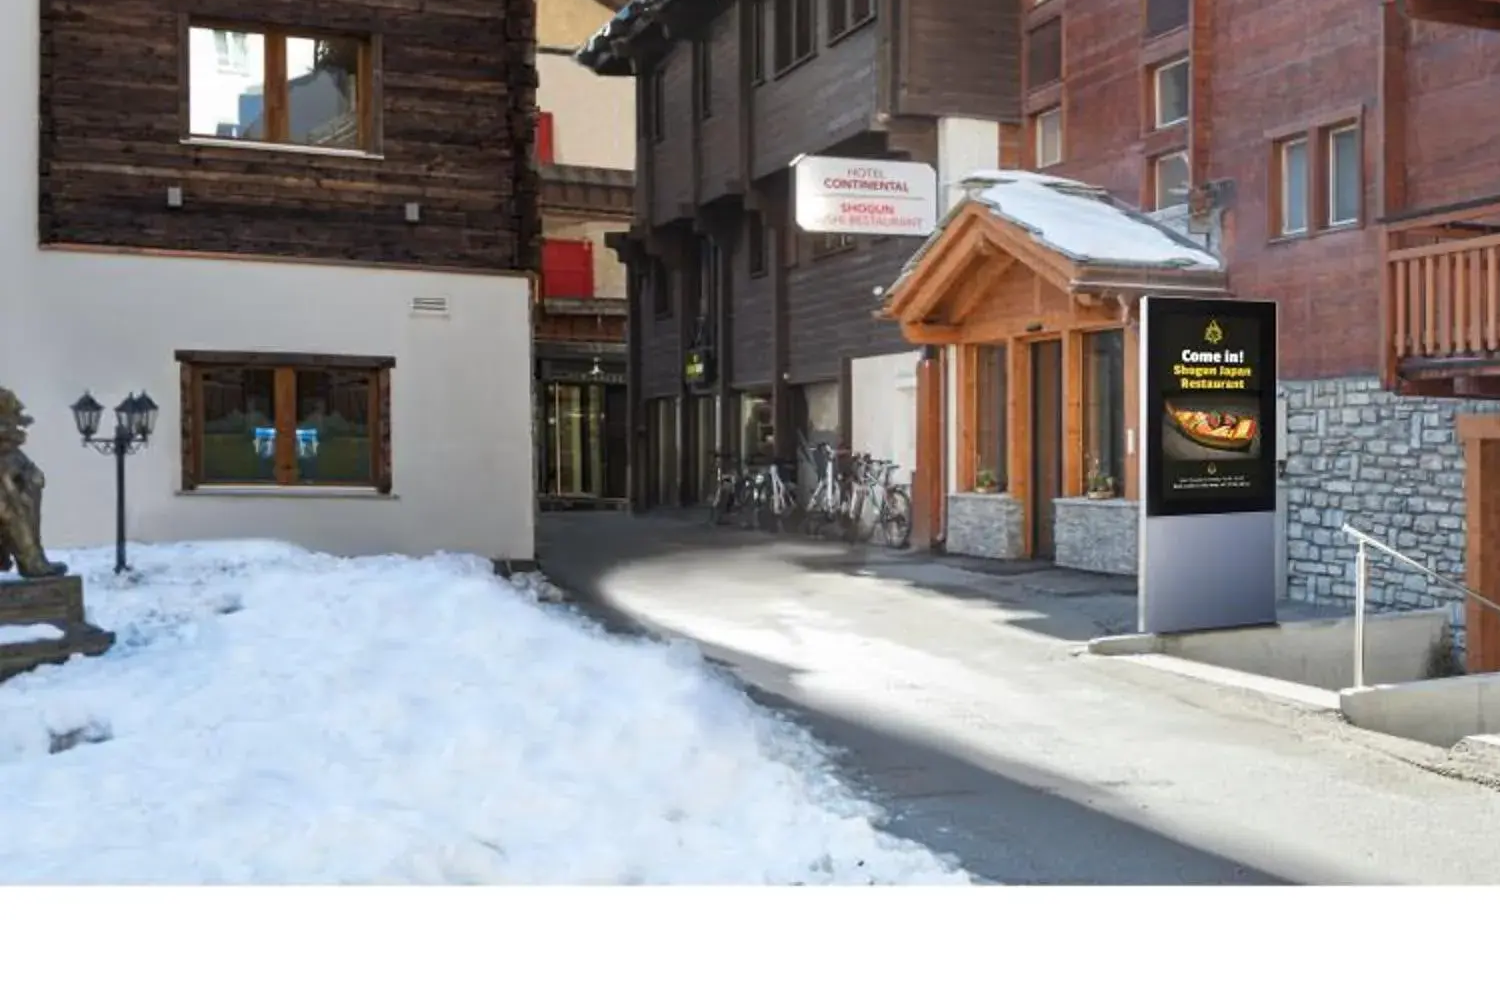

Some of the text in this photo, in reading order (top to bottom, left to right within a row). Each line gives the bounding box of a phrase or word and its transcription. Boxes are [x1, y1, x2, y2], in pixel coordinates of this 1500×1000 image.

[848, 167, 885, 179] HOTEL
[824, 178, 909, 193] CONTINENTAL
[841, 203, 895, 215] SHOGUN
[1181, 349, 1245, 363] Come in!
[1173, 364, 1252, 377] Shogun Japan
[1181, 378, 1245, 389] Restaurant
